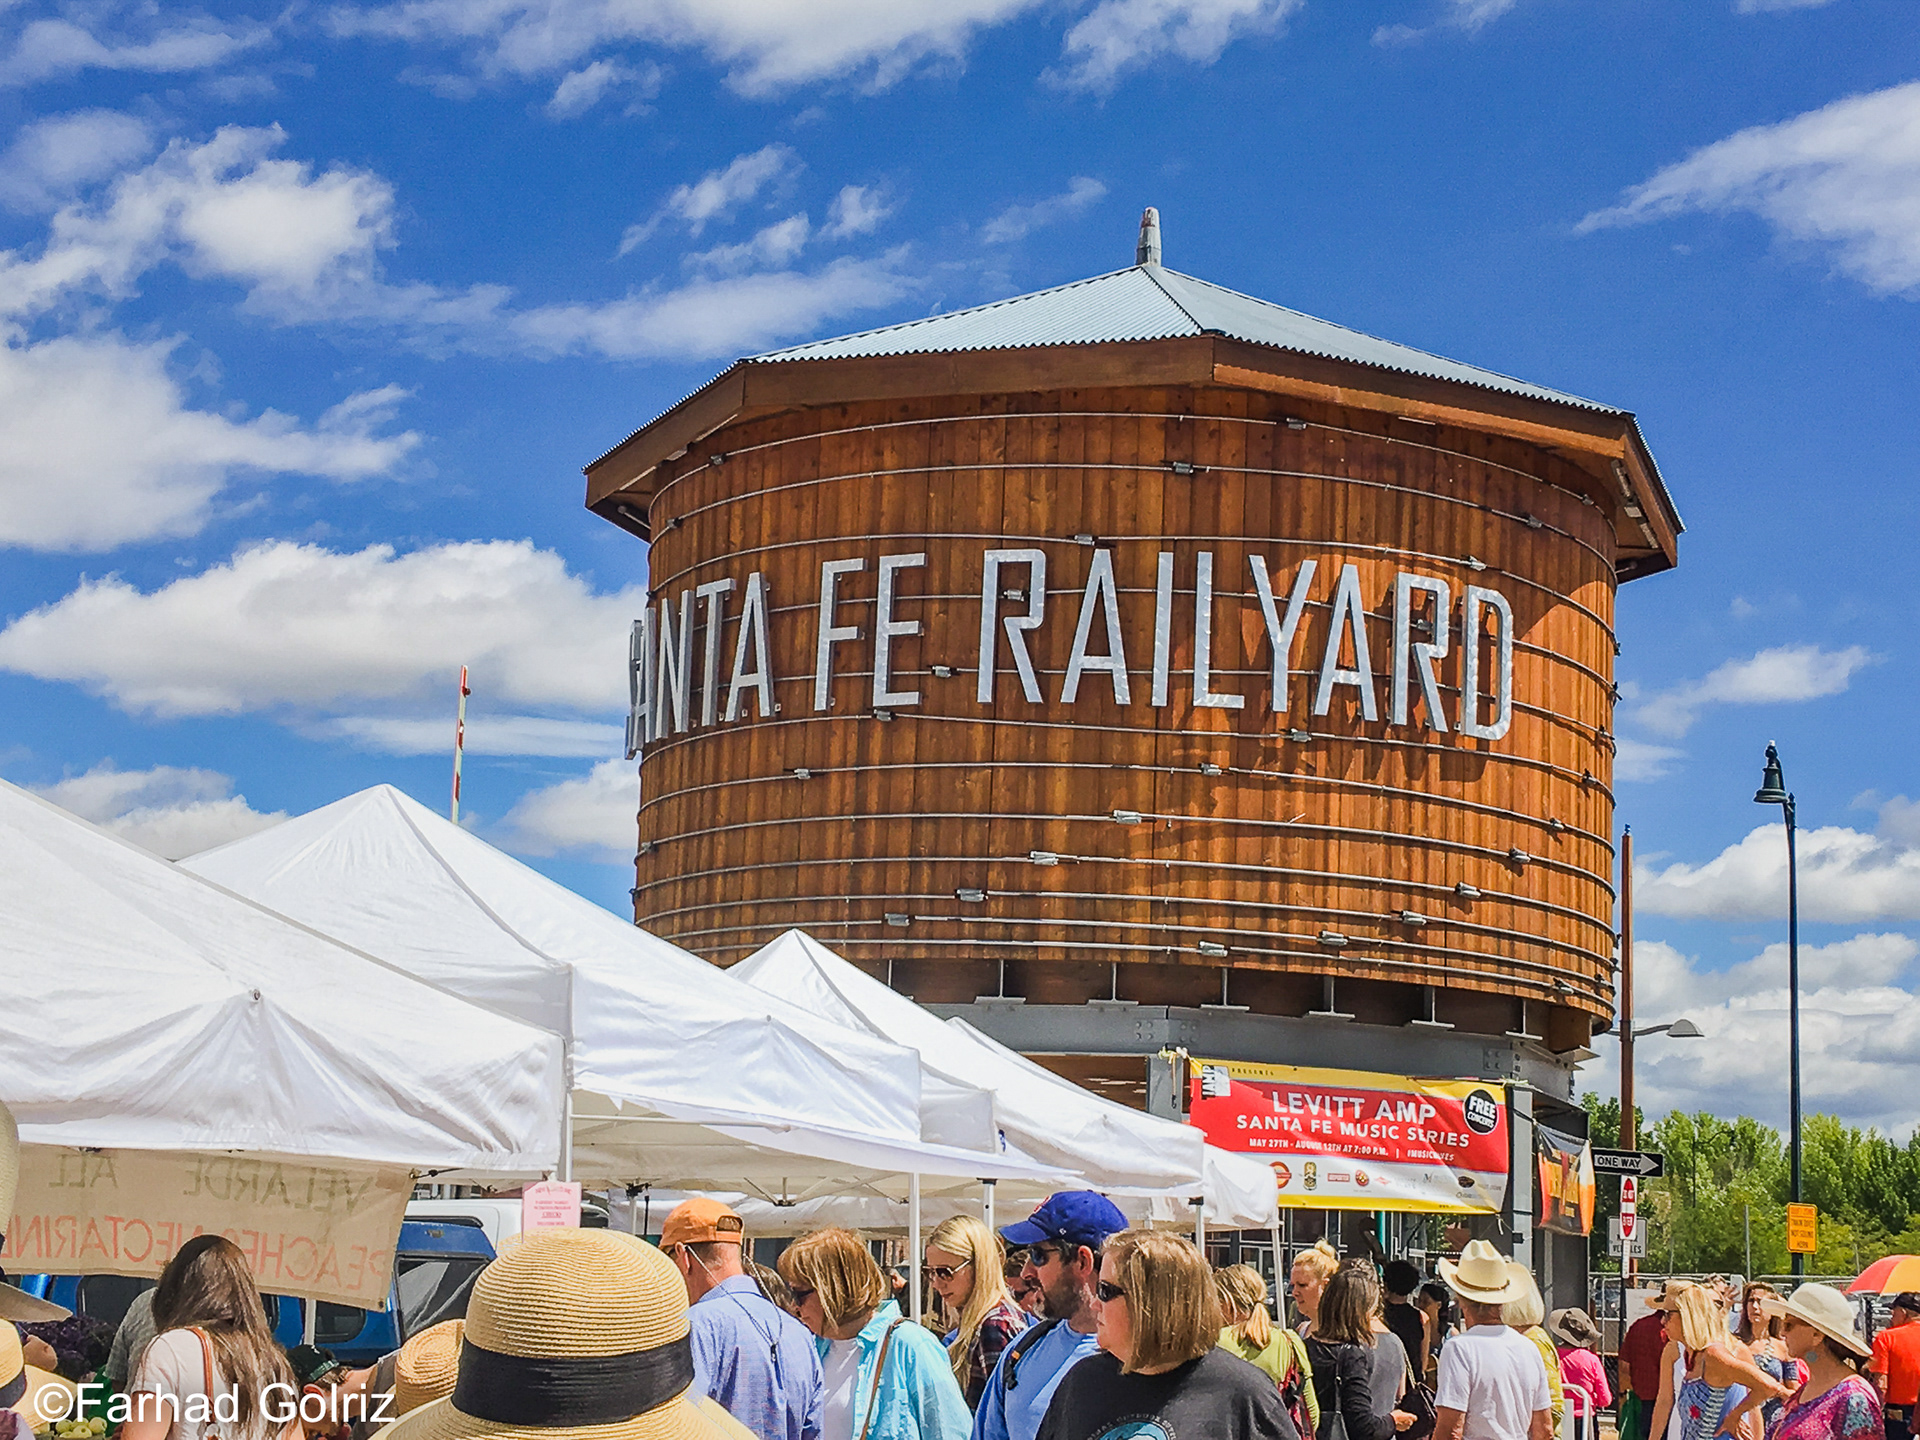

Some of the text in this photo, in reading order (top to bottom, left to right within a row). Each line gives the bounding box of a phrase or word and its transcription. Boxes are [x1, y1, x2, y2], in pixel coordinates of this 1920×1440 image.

[814, 553, 927, 711] FE
[977, 548, 1513, 741] RAILYARD
[1272, 1091, 1436, 1125] LEVITT AMP
[1468, 1095, 1496, 1120] FREE
[1236, 1115, 1470, 1148] SANTA FE MUSIC SERIES
[1249, 1138, 1267, 1147] MAY
[1268, 1139, 1289, 1148] 27TH
[1323, 1142, 1341, 1152] 12TH
[1342, 1144, 1352, 1153] AT
[1354, 1145, 1371, 1154] 7:00
[1372, 1146, 1389, 1156] P.M.
[1597, 1156, 1641, 1168] ONE WAY
[1612, 1244, 1642, 1254] VELES
